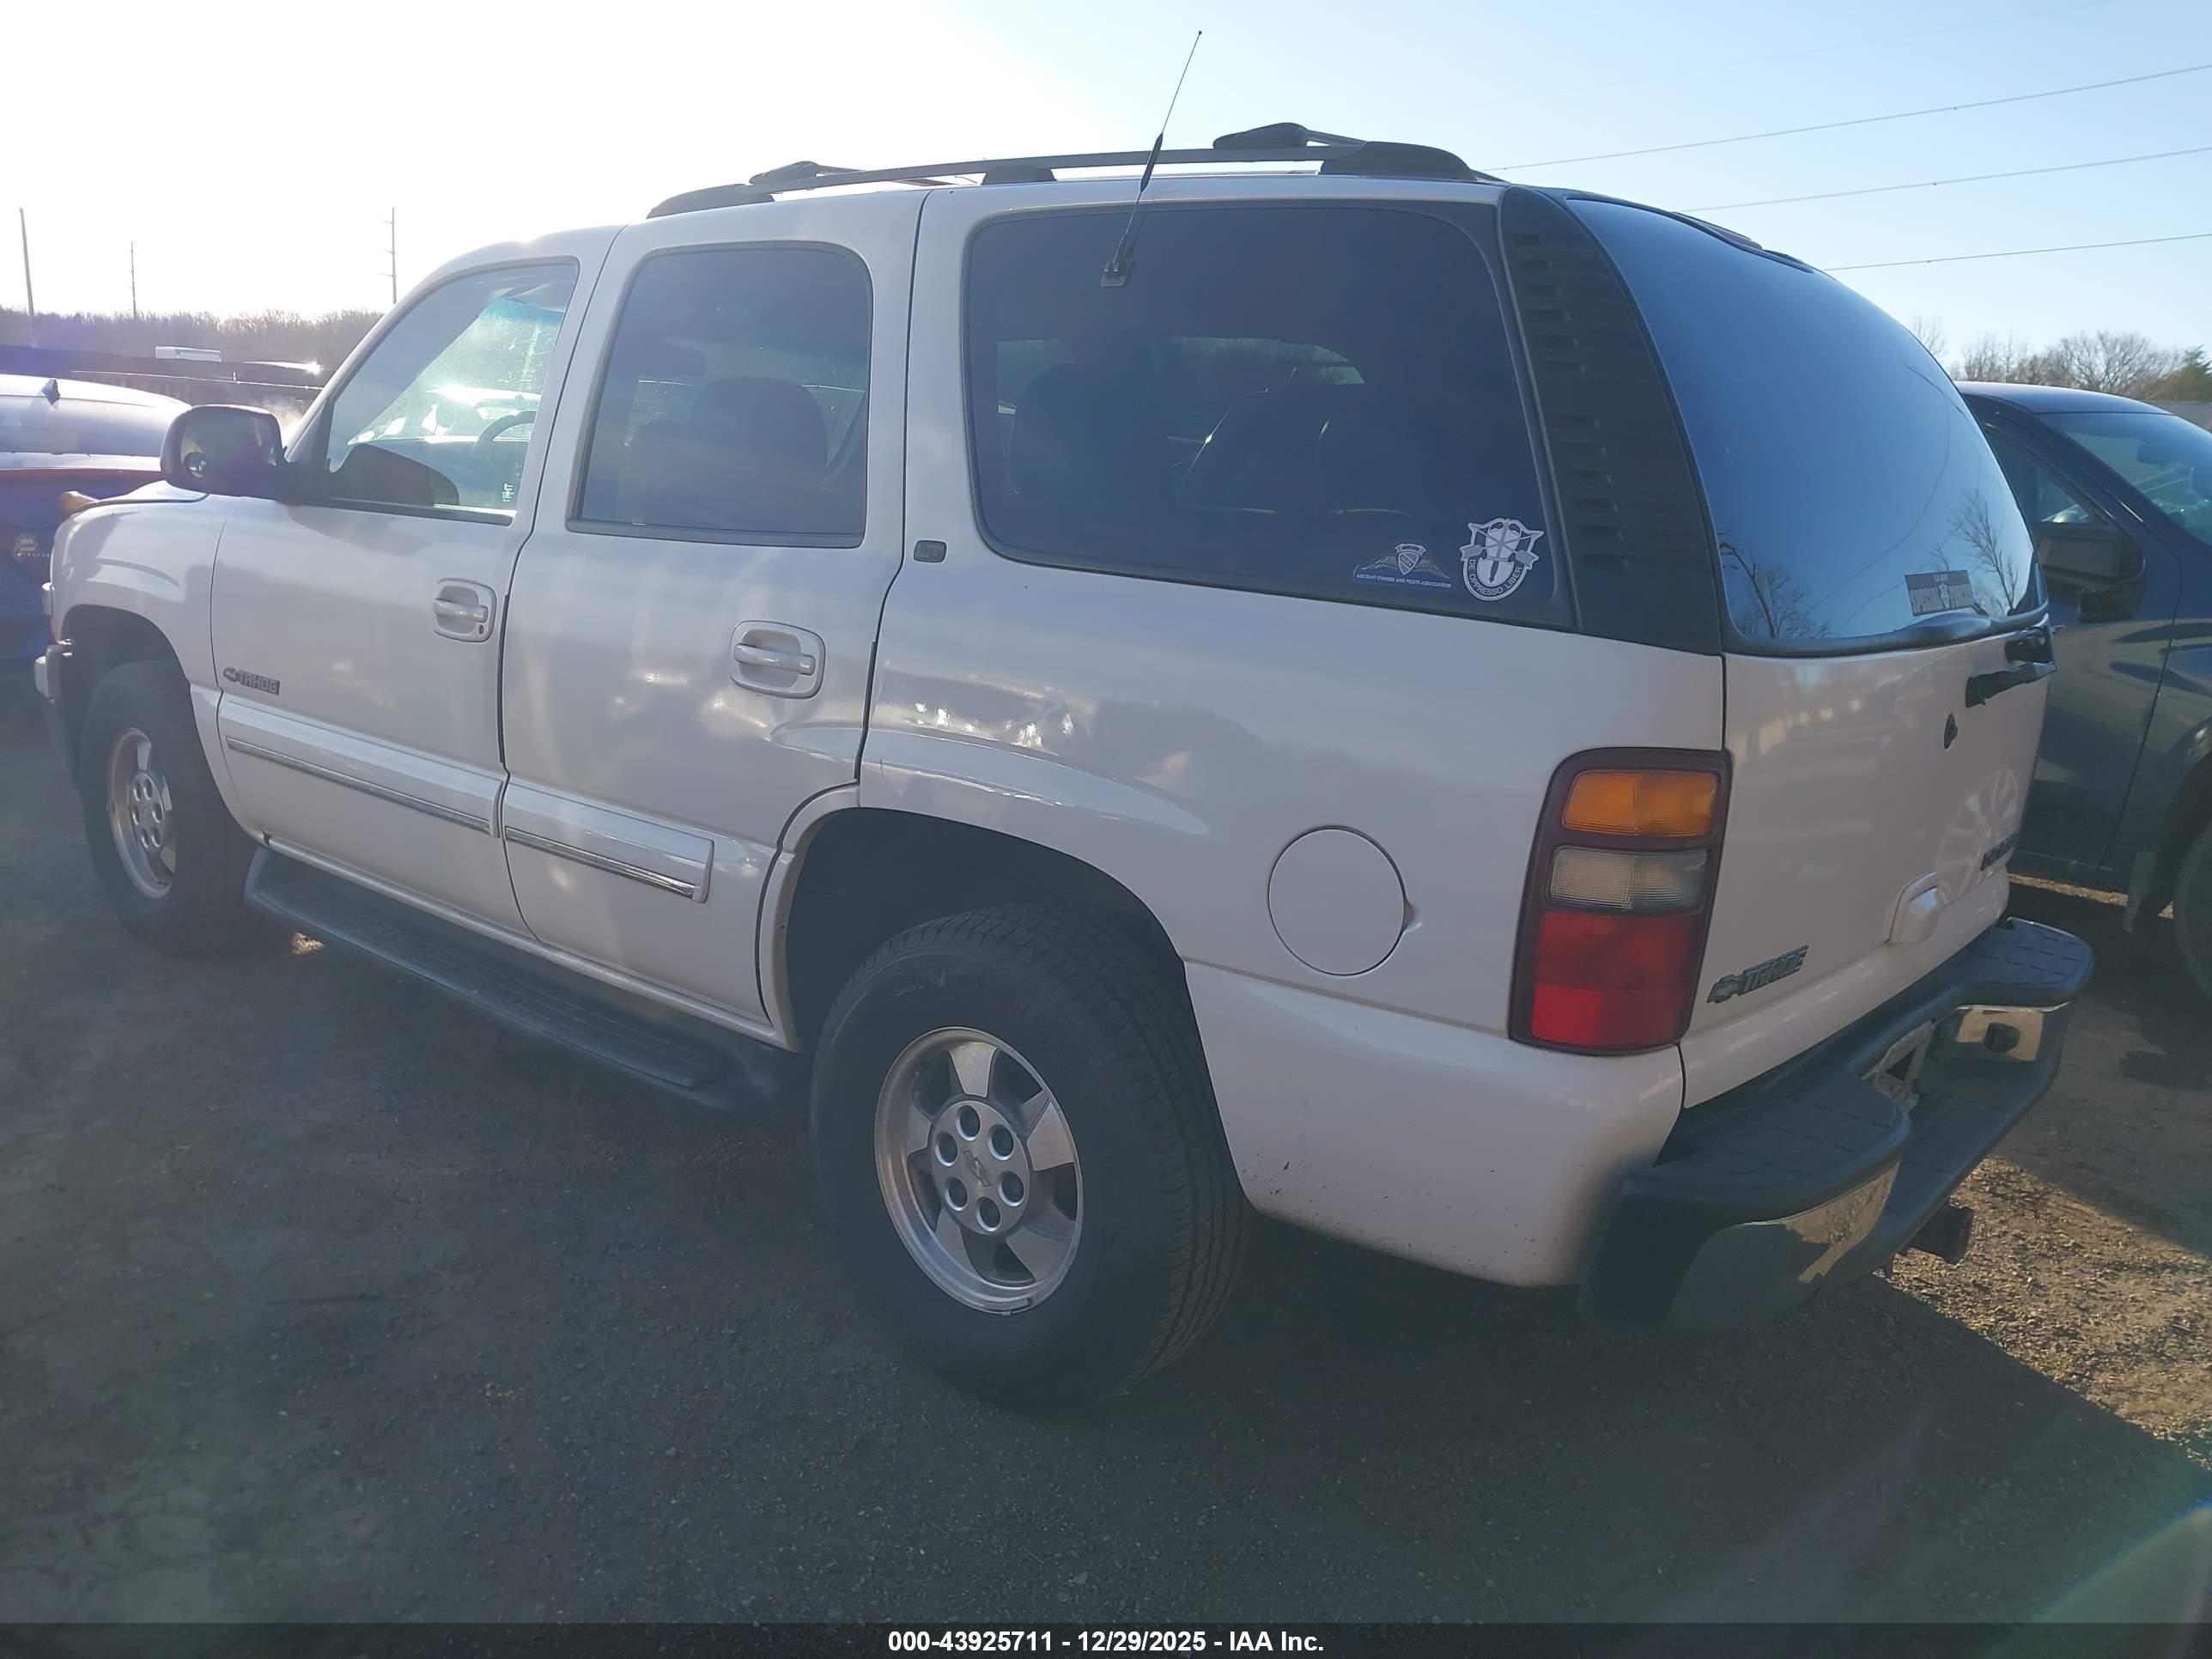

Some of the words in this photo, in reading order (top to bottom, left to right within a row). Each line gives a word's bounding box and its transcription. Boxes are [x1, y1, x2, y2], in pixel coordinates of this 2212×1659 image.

[1468, 559, 1476, 571] DE
[1356, 573, 1376, 581] AIRCRAFT
[1469, 573, 1504, 596] OPPRESSO
[1504, 567, 1522, 589] LIBER
[240, 670, 281, 696] TAHOE
[1741, 945, 1809, 995] TAHOE
